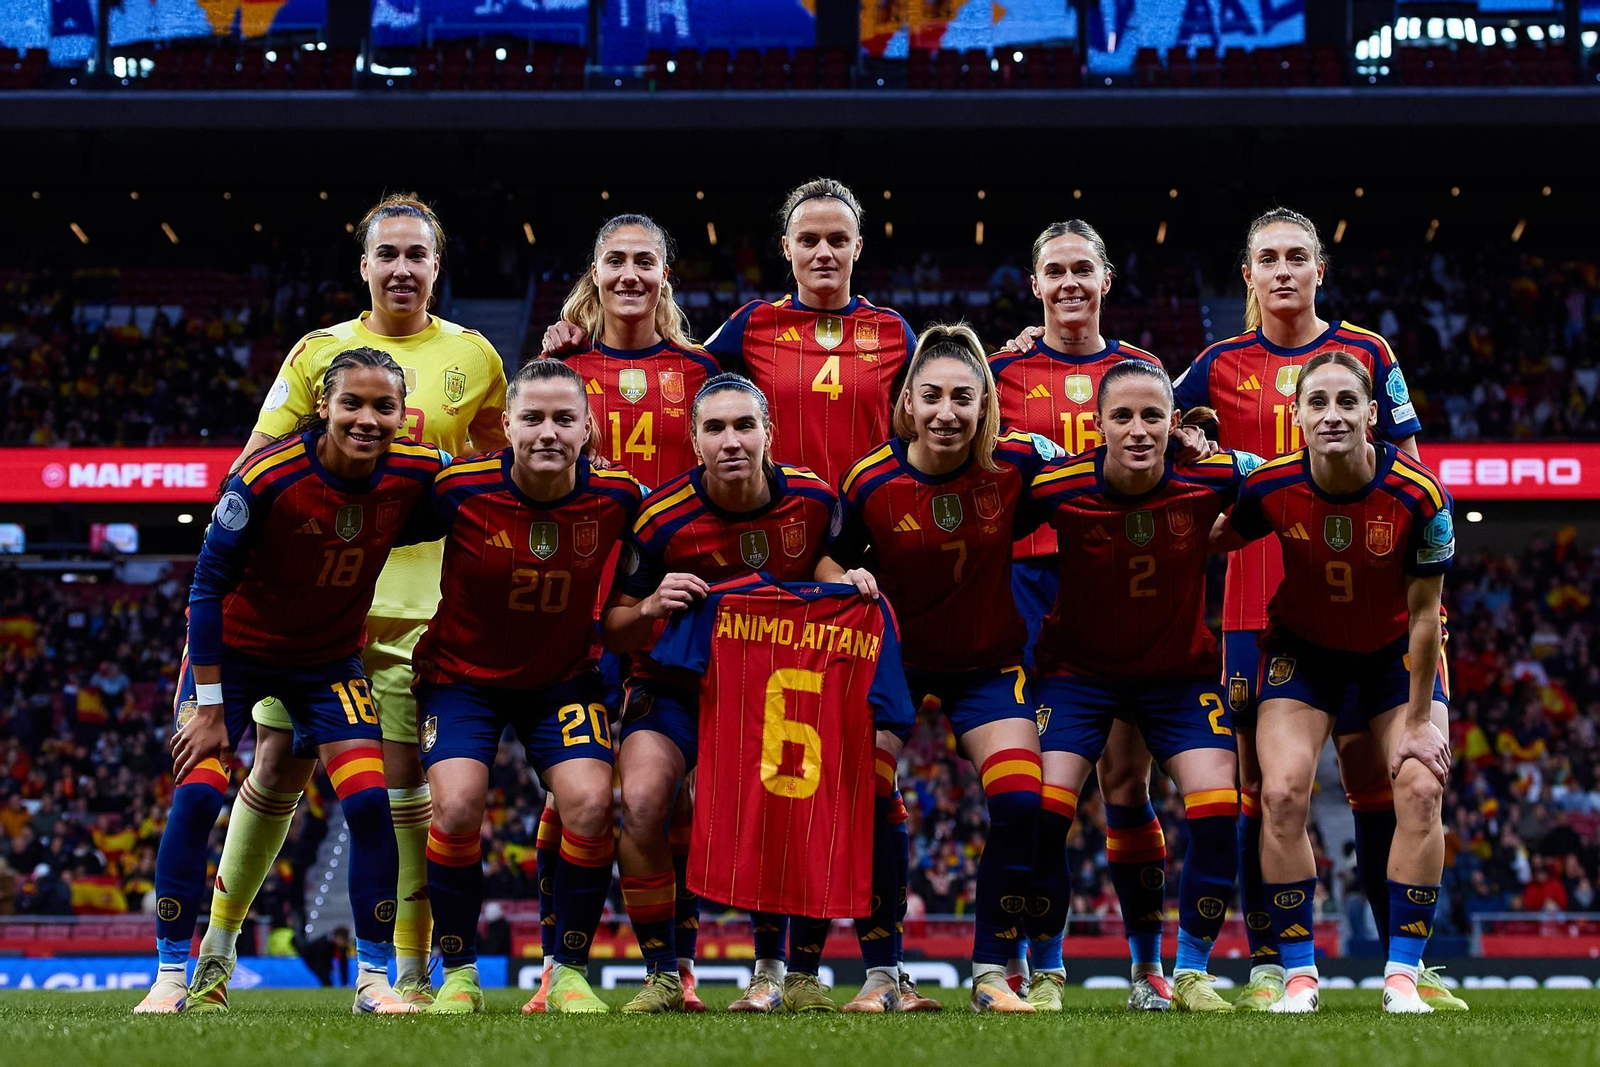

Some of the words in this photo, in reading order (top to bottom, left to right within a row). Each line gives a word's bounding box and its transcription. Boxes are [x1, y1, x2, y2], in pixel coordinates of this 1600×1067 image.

[812, 355, 843, 400] 4
[608, 411, 657, 461] 14
[68, 462, 209, 488] MAPFRE
[315, 547, 364, 587] 18
[941, 539, 967, 584] 7
[1128, 555, 1157, 597] 2
[1325, 560, 1353, 602] 9
[507, 568, 571, 613] 20
[330, 678, 379, 725] 18
[1000, 665, 1027, 704] 7
[558, 702, 612, 749] 20
[760, 667, 825, 799] 6
[1199, 692, 1232, 736] 2
